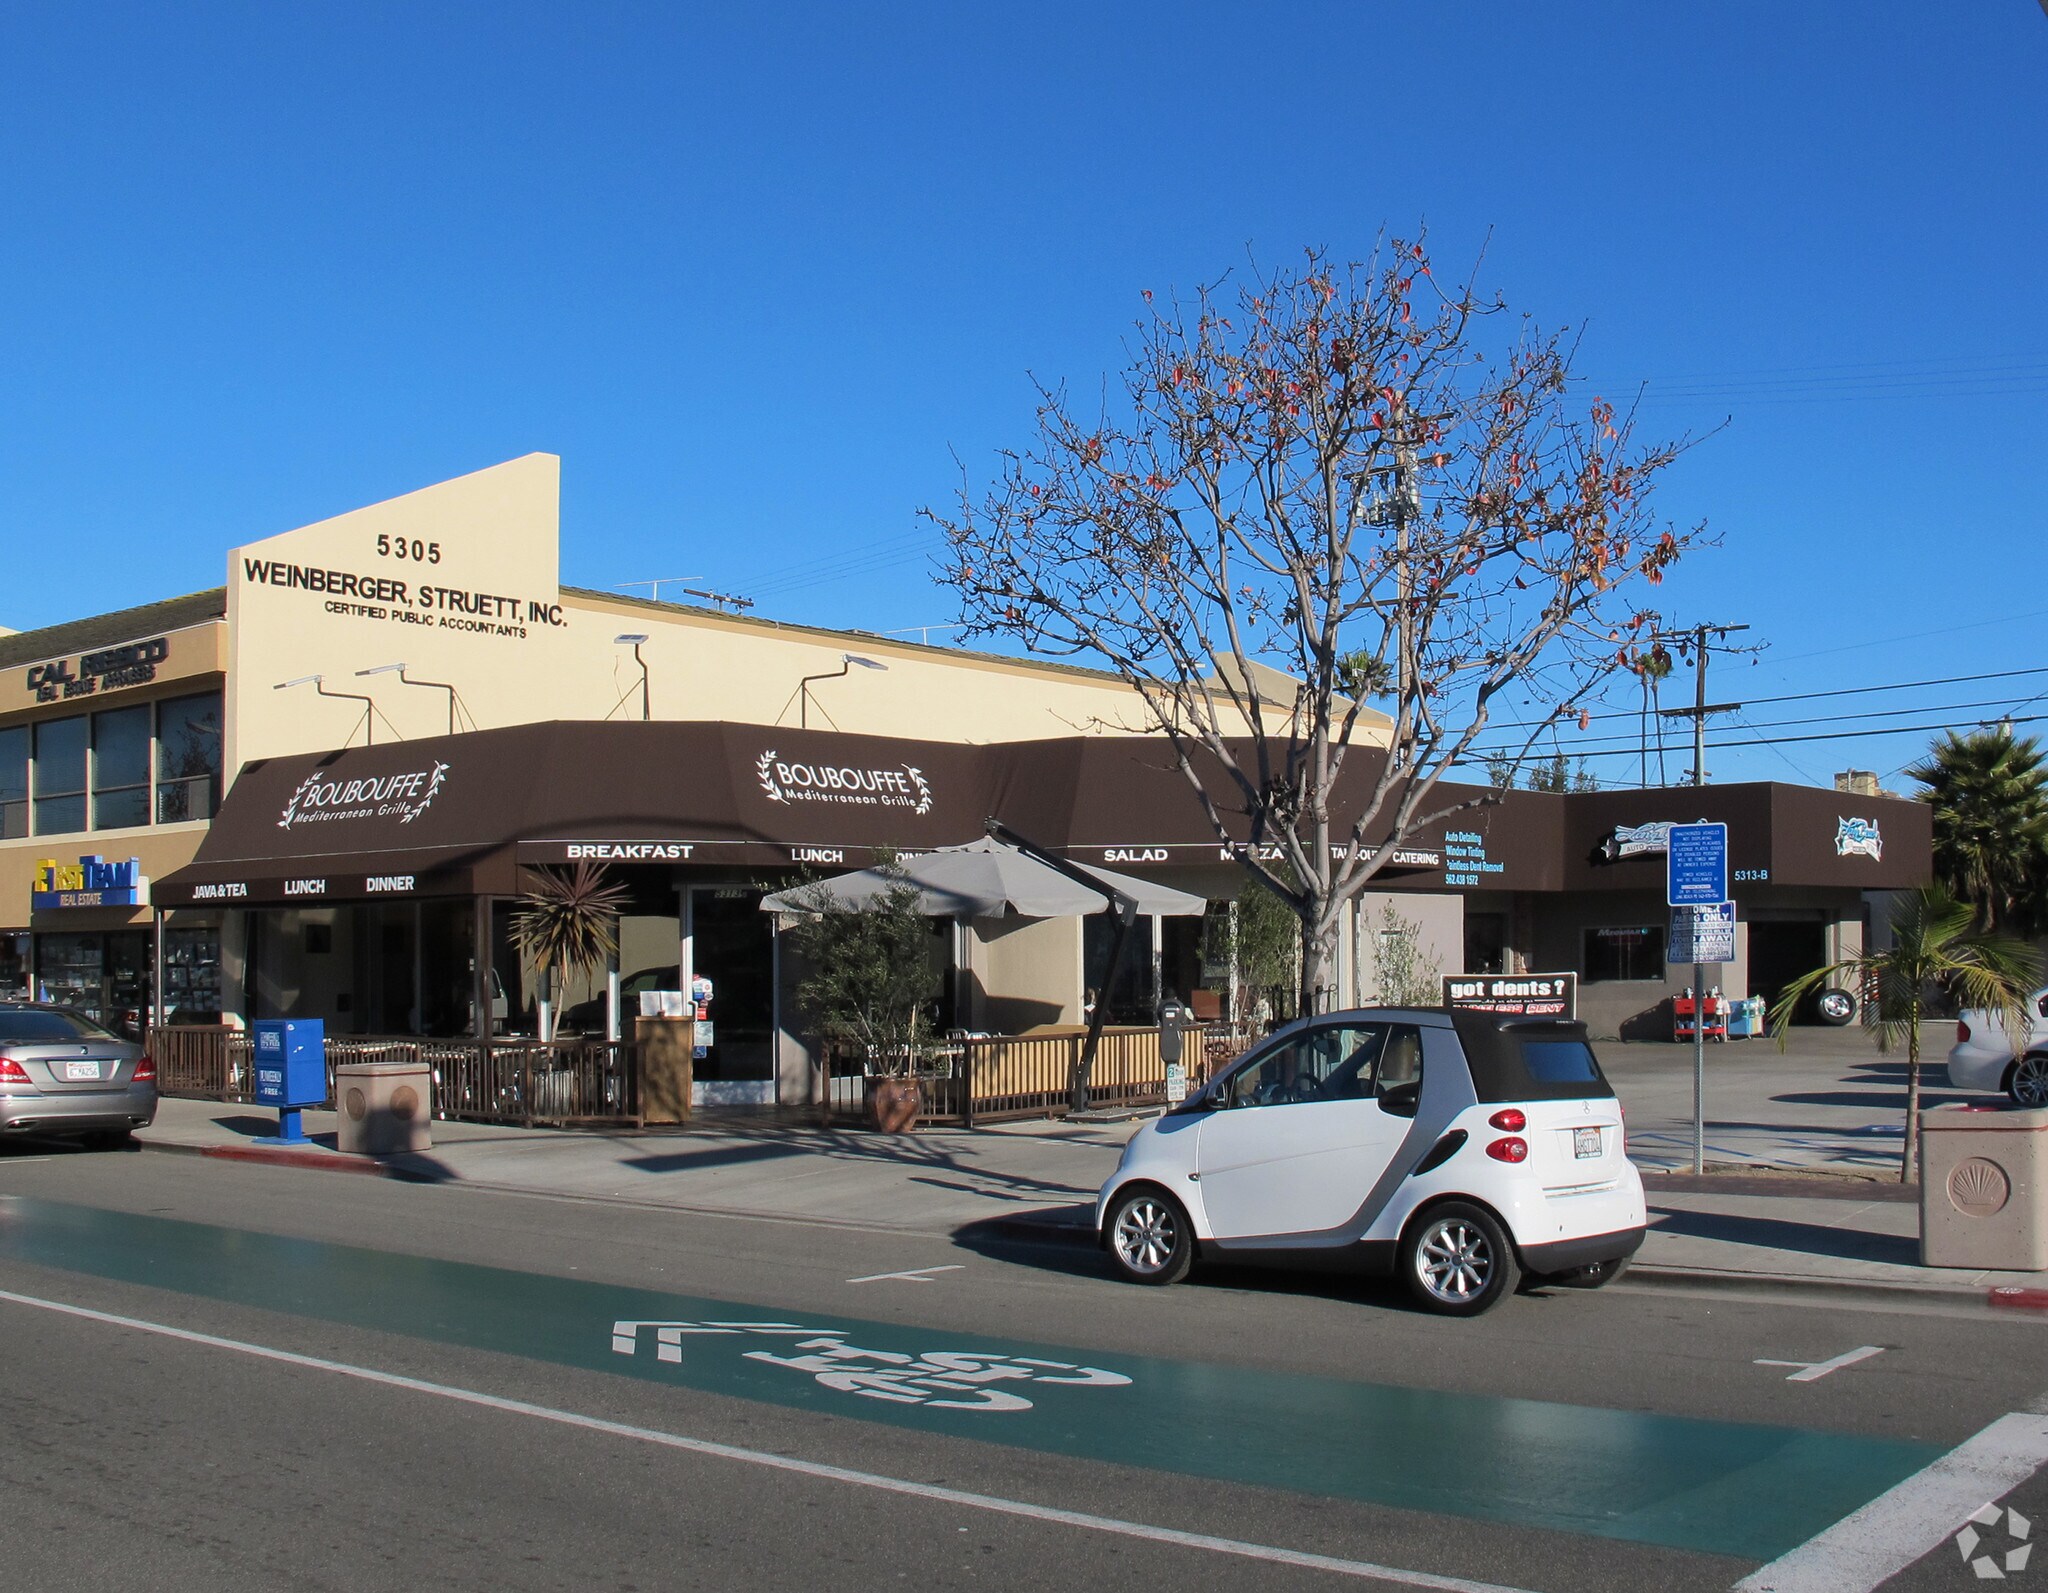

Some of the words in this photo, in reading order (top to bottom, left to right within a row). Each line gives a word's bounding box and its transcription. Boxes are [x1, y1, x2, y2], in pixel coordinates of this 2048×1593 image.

[376, 533, 441, 564] 5305
[244, 557, 412, 608] WEINBERGER,
[418, 585, 524, 624] STRUETT,
[528, 601, 568, 628] INC.
[324, 600, 387, 620] CERTIFIED
[391, 610, 434, 626] PUBLIC
[438, 618, 528, 639] ACCOUNTANTS
[28, 660, 76, 690] CAL
[773, 762, 910, 793] BOUBOUFFE
[302, 772, 428, 808] BOUBOUFFE
[785, 788, 878, 805] Mediterranean
[881, 795, 916, 808] Grille
[294, 808, 373, 824] Mediterranean
[378, 802, 412, 816] Grille
[1458, 832, 1482, 846] Detailing
[567, 844, 694, 860] BREAKFAST
[792, 848, 844, 864] LUNCH
[1104, 848, 1169, 862] SALAD
[1220, 848, 1285, 861] MZA
[1392, 851, 1439, 865] CATERING
[1445, 845, 1467, 856] Window
[1468, 846, 1486, 860] Tinting
[1470, 860, 1482, 871] Dent
[1483, 861, 1504, 872] Removal
[1466, 874, 1479, 885] 1572
[1734, 870, 1768, 881] 5313-B
[284, 880, 326, 895] LUNCH
[366, 876, 415, 892] DINNER
[60, 894, 77, 906] REAL
[78, 892, 102, 906] ESTATE
[1703, 913, 1729, 922] ONLY
[1450, 982, 1484, 998] got
[1526, 1003, 1565, 1014] DENT
